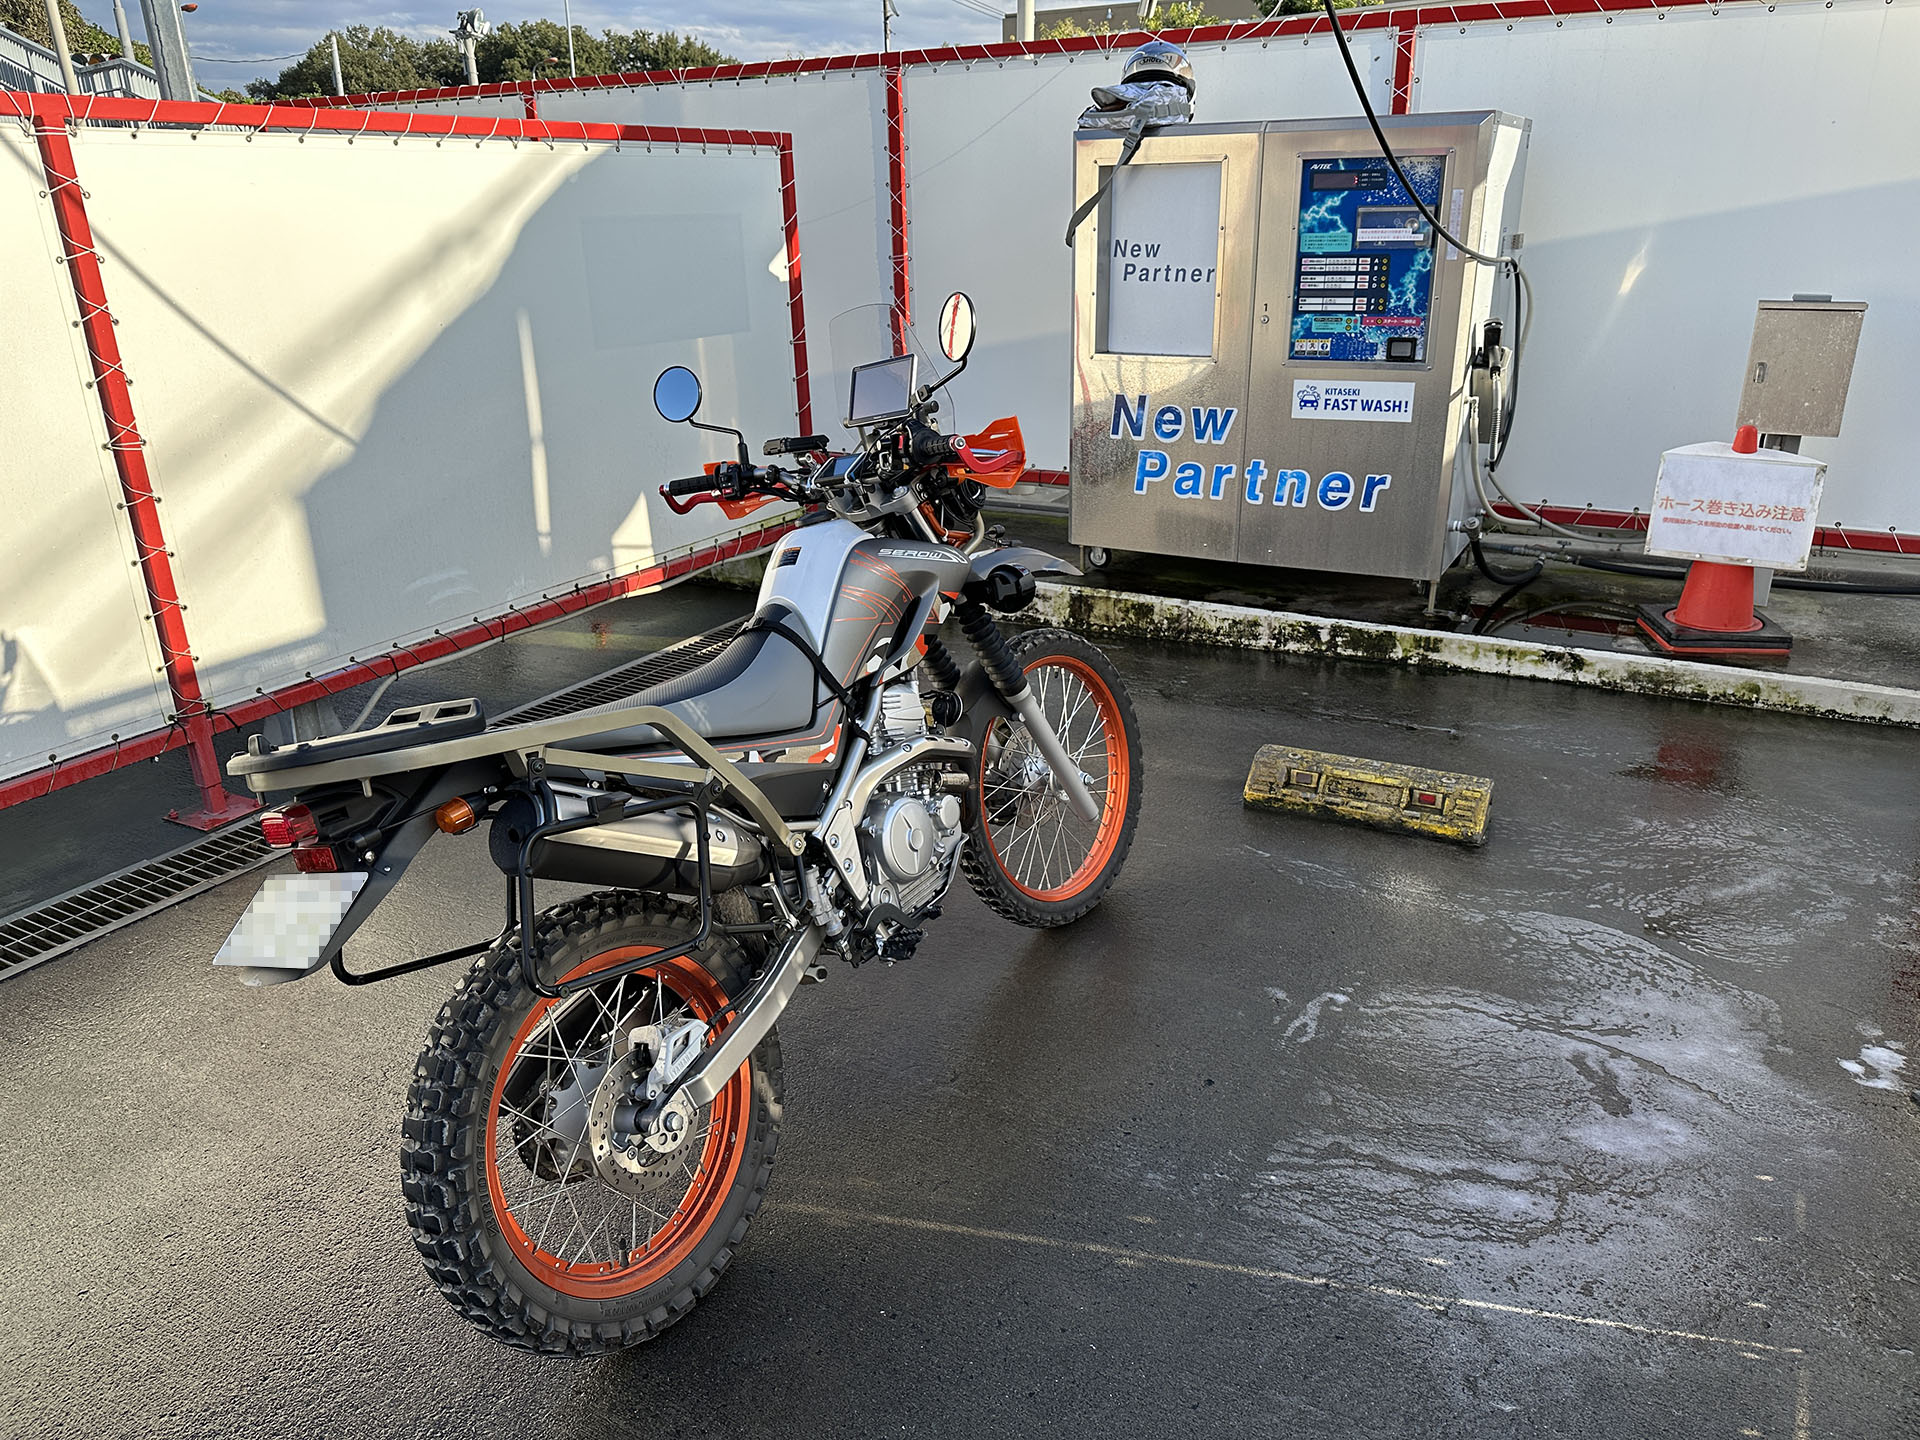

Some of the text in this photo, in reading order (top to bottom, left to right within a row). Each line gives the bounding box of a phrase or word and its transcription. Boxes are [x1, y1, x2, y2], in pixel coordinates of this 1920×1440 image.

[1113, 239, 1161, 258] New
[1123, 263, 1215, 282] Partner
[1263, 303, 1268, 312] 1
[1325, 387, 1361, 396] KITASEKI
[1323, 398, 1409, 413] FAST WASH!
[1110, 393, 1237, 444] New
[1134, 450, 1392, 512] Partner
[1658, 495, 1807, 523] ホース巻き込み注意
[877, 548, 943, 560] SEROW
